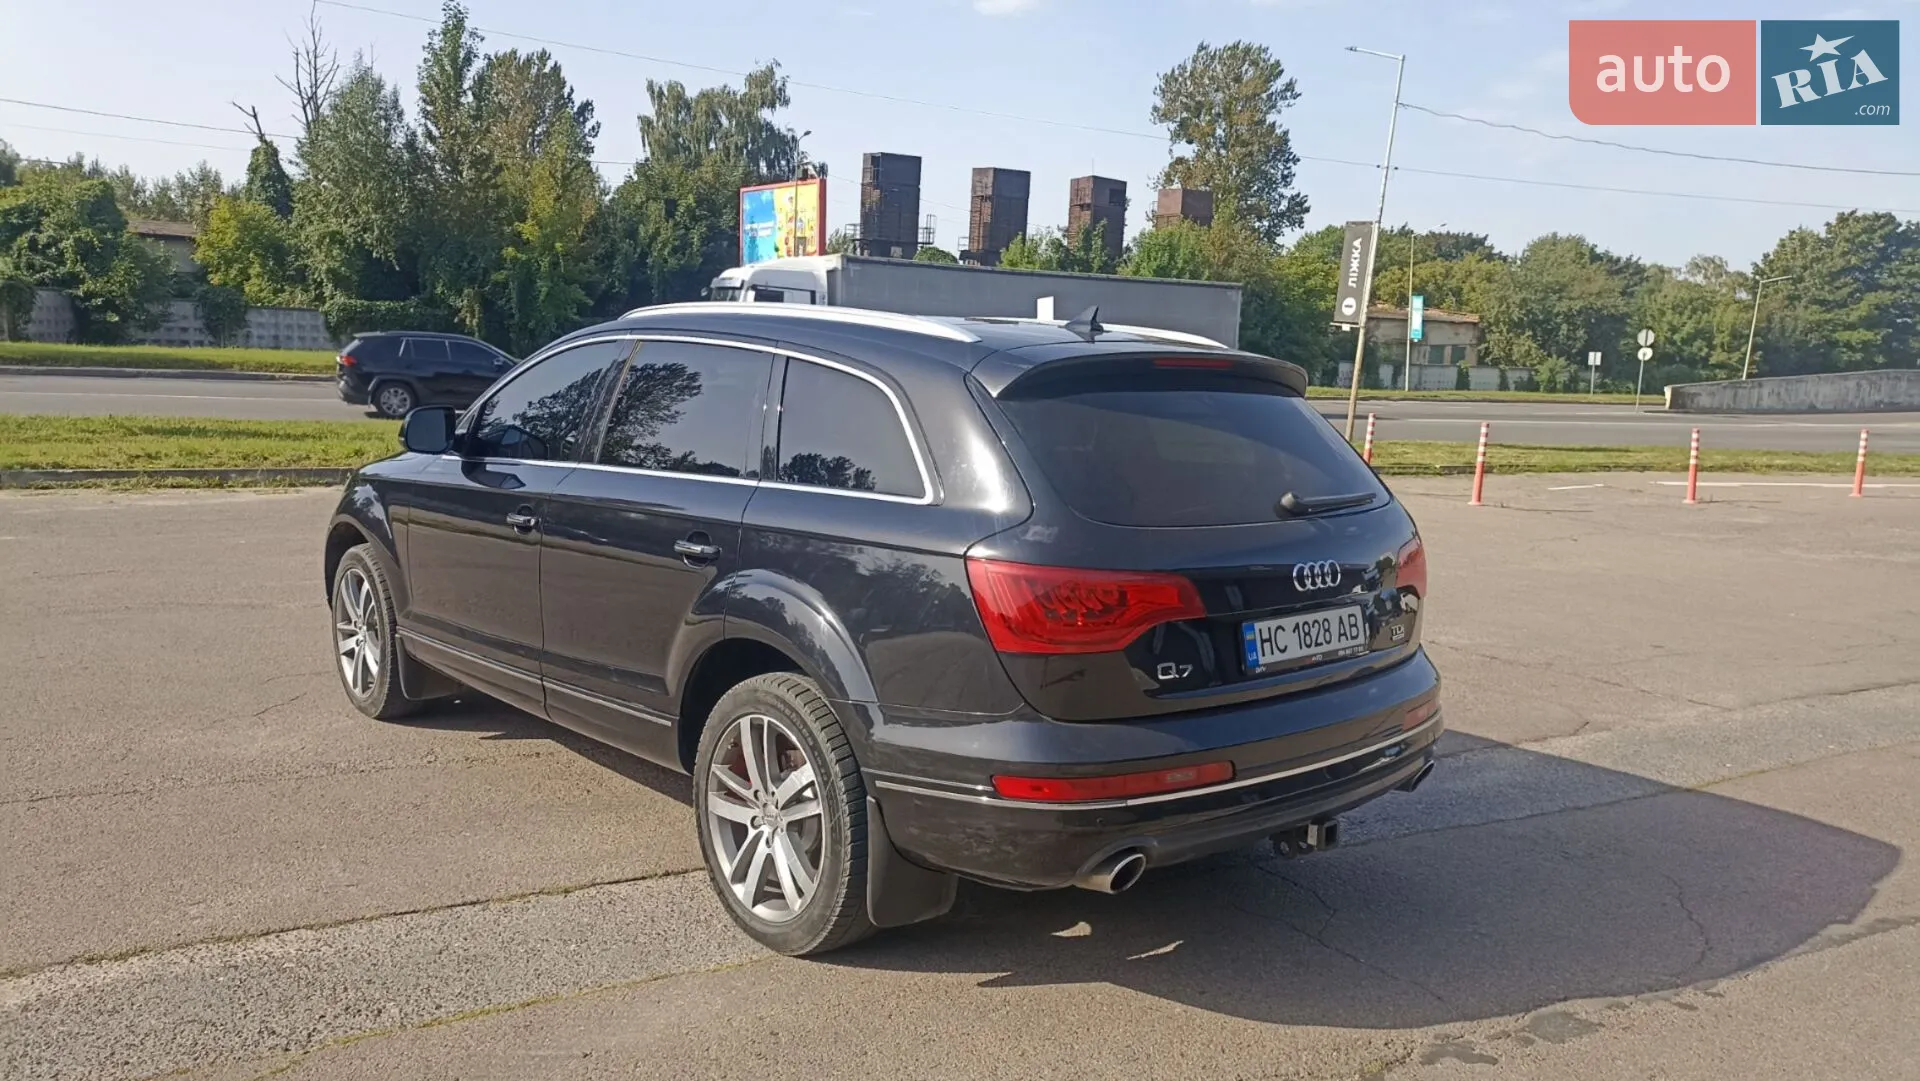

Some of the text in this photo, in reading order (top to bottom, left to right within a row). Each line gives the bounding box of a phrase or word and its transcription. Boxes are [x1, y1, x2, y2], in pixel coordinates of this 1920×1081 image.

[1347, 237, 1362, 289] ЛІЖКА
[1258, 613, 1360, 657] HC 1828 AB
[1157, 662, 1194, 679] Q7
